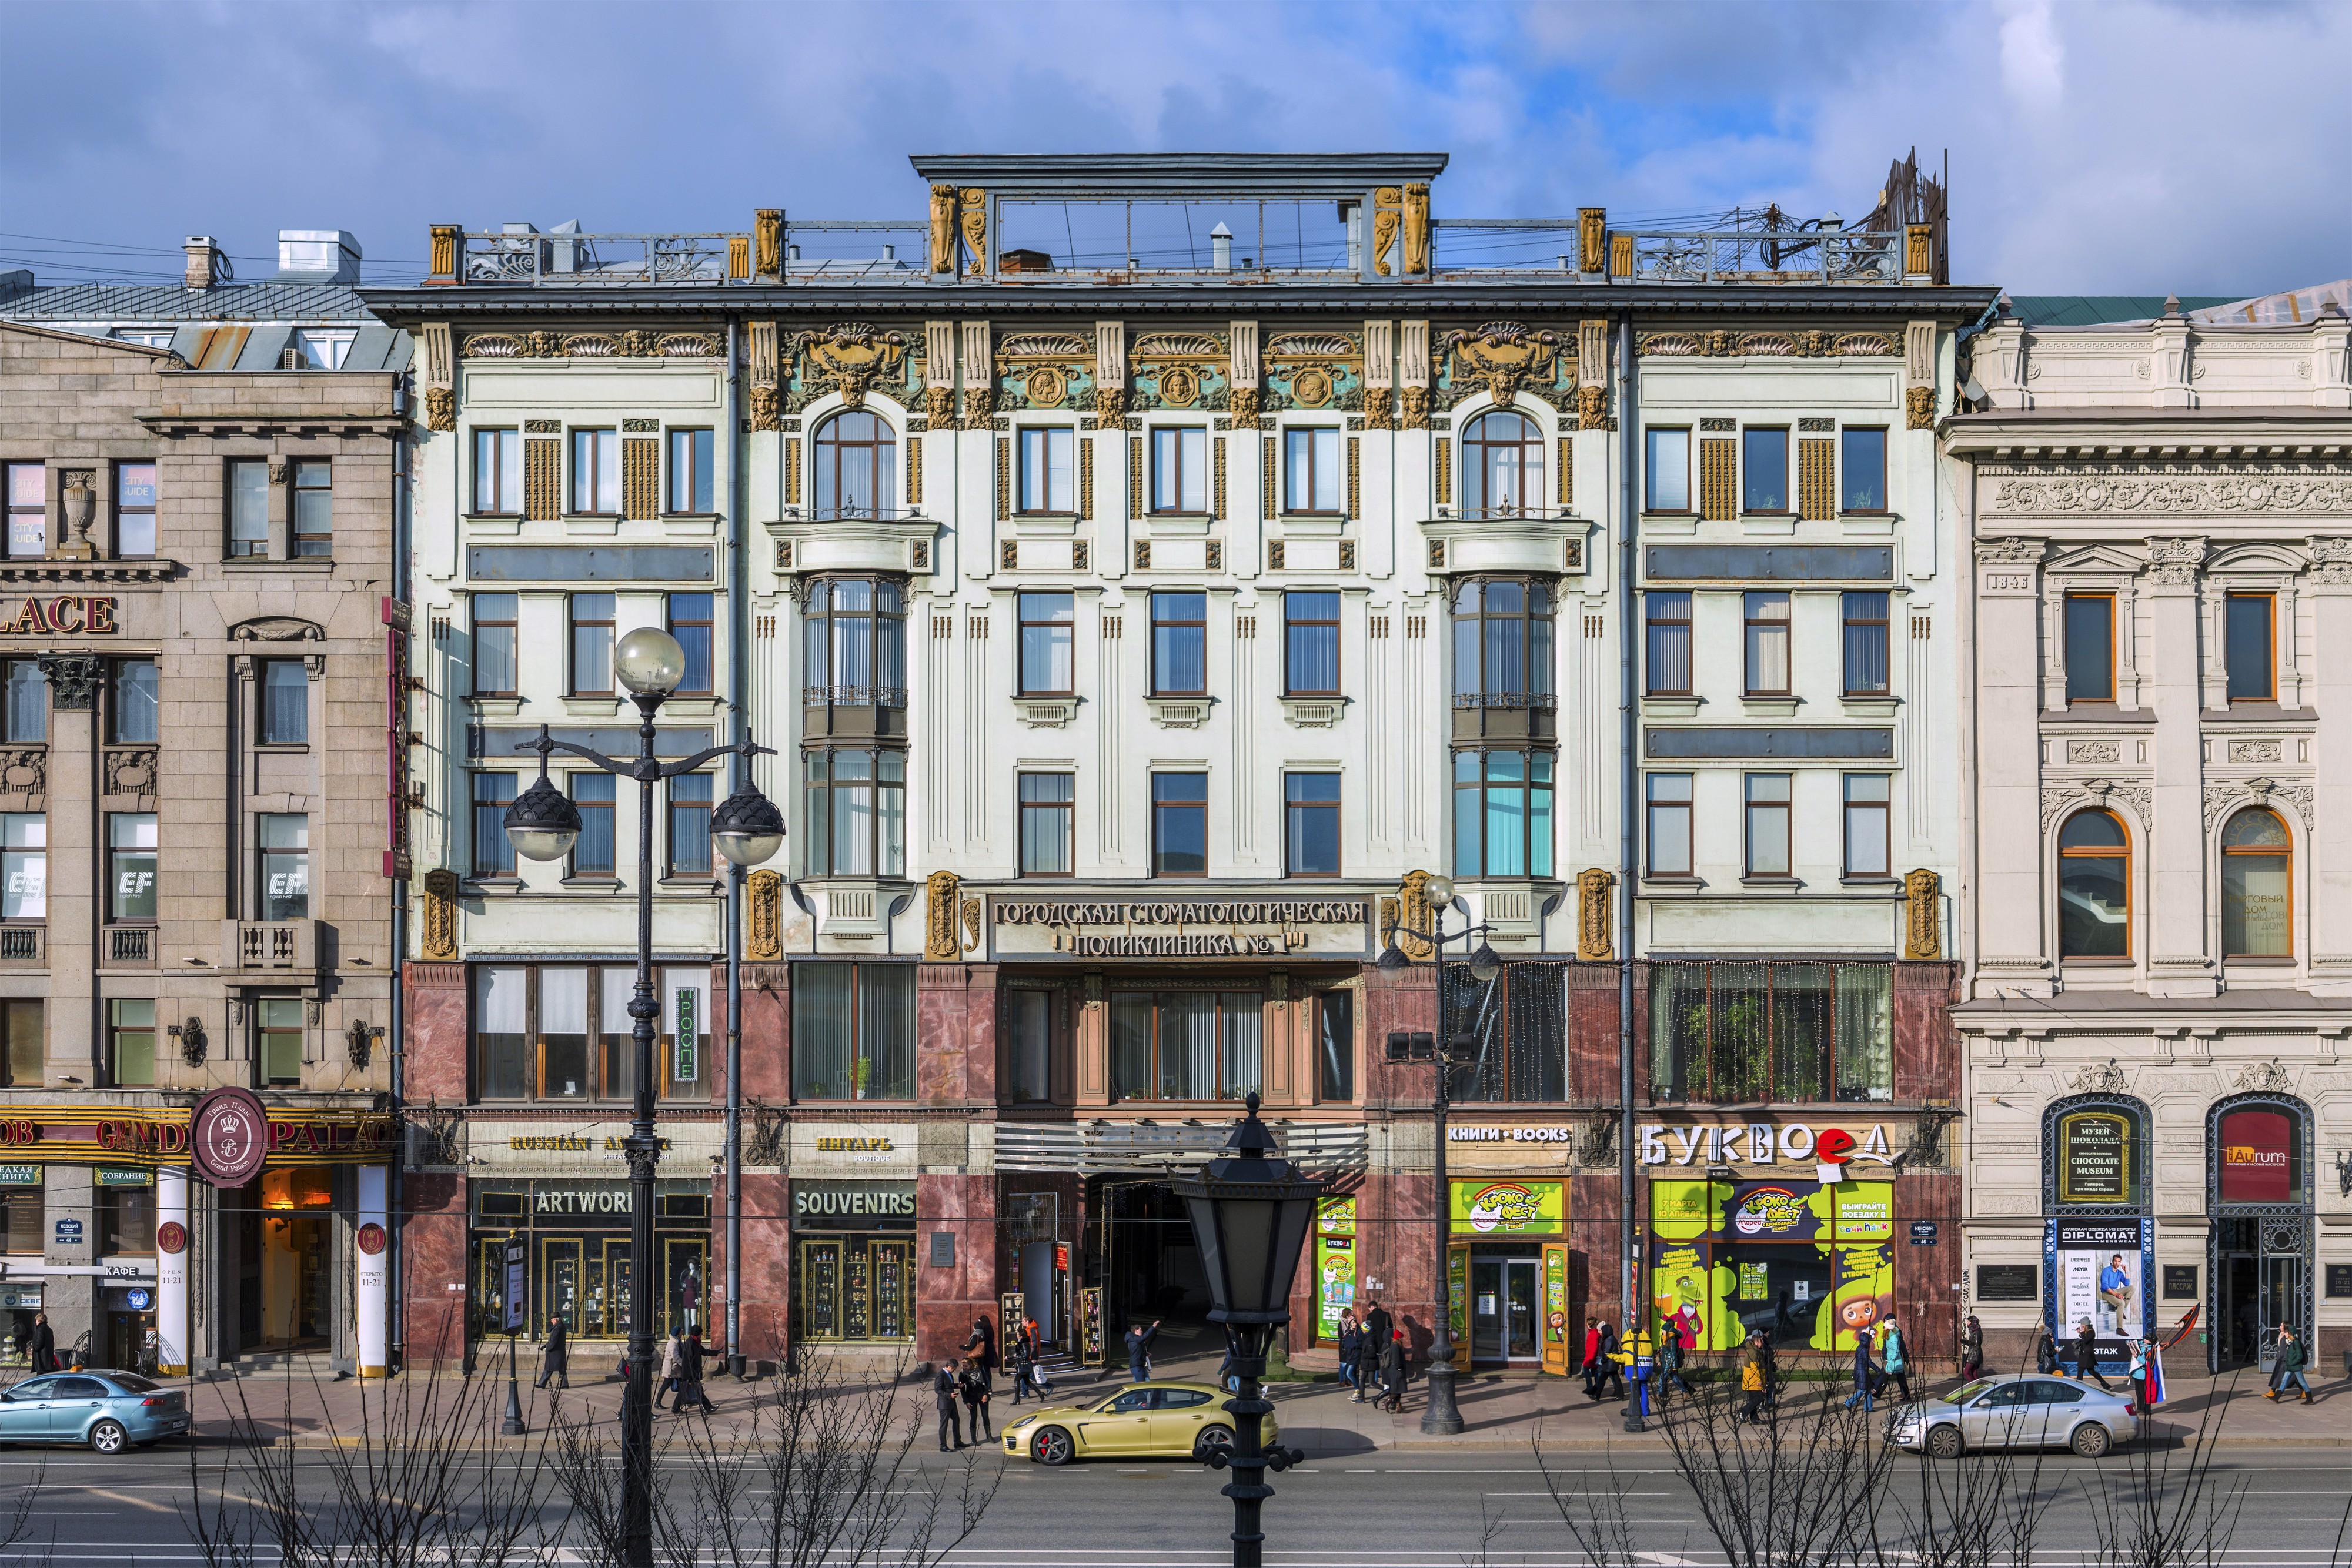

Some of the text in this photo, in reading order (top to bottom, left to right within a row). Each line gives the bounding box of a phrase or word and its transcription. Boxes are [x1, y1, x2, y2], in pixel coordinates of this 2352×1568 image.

[1991, 576, 2029, 589] 1846
[0, 596, 113, 632] ACE
[119, 872, 153, 893] EF
[269, 873, 303, 894] EF
[2229, 894, 2283, 903] ТОРГОВЫЙ
[994, 902, 1365, 927] ГОРОДСКАЯ СТОМАТОЛОГИЧЕСКАЯ
[1075, 934, 1288, 956] ПОЛИКЛИНИКА № 1
[207, 1102, 252, 1118] Гранд Палас
[95, 1119, 186, 1153] GRAND
[266, 1121, 399, 1152] PALACE
[1448, 1128, 1568, 1141] КНИГИ BOOKS
[510, 1136, 589, 1150] RUSSIAN
[816, 1136, 891, 1151] ЯНТАРЬ
[2234, 1149, 2286, 1163] Aurum
[210, 1159, 249, 1172] Grand Palace
[795, 1192, 914, 1214] SOUVENIRS
[1479, 1192, 1524, 1212] КРОКО
[1745, 1195, 1789, 1214] КРОКО
[1326, 1206, 1347, 1219] КРОКО
[1501, 1205, 1536, 1219] ФЕСТ
[1766, 1207, 1800, 1221] ФЕСТ
[1660, 1254, 1700, 1265] ОЛИМПИАДА
[1663, 1248, 1696, 1258] СЕМЕЙНАЯ
[1846, 1249, 1879, 1259] СЕМЕЙНАЯ
[1327, 1261, 1346, 1272] КРОКО
[1843, 1255, 1883, 1266] ОЛИМПИАДА
[105, 1266, 136, 1276] КАФЕ
[1336, 1268, 1351, 1277] ФЕСТ
[1665, 1266, 1704, 1276] ТВОРЧЕСТВА
[1847, 1267, 1887, 1278] ТВОРЧЕСТВА
